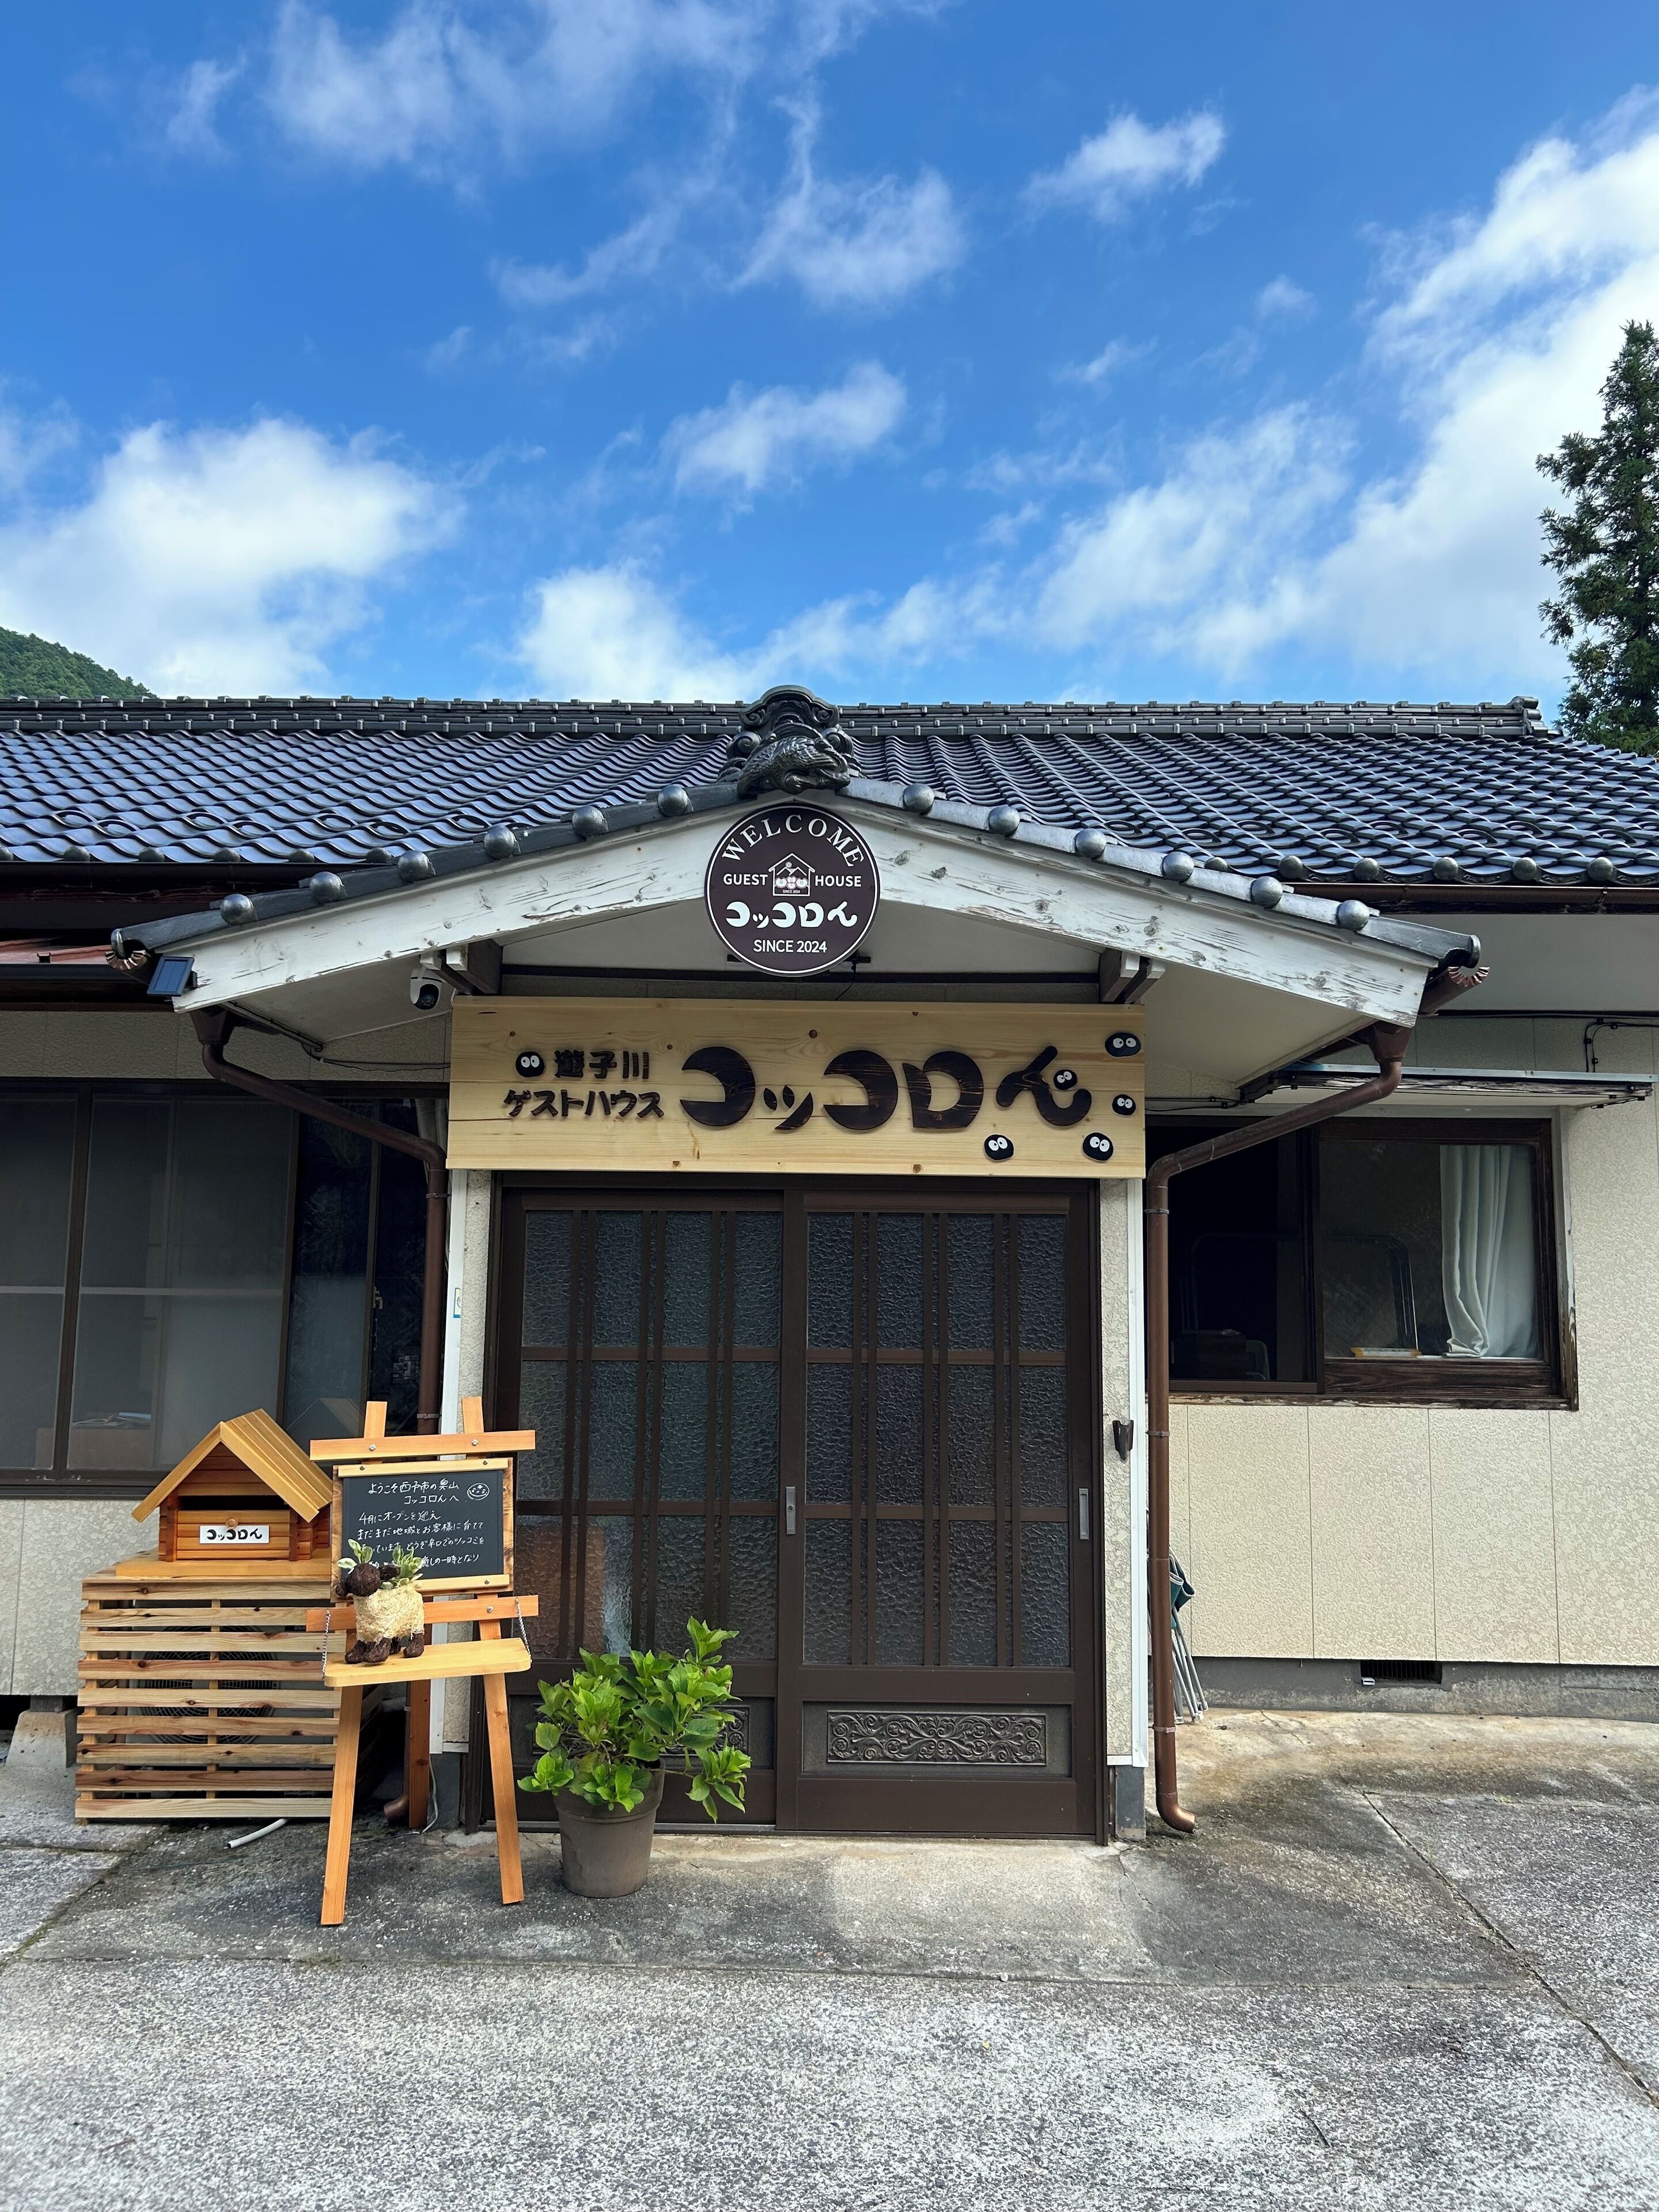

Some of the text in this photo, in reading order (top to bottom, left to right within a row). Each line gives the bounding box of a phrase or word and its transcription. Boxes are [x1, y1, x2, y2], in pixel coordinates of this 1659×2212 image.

[721, 815, 865, 868] WELCOME
[723, 873, 862, 888] GUEST HOUSE
[726, 901, 858, 929] コッコロん
[753, 940, 827, 953] SINCE 2024
[554, 1050, 650, 1080] 遊子川
[679, 1046, 1092, 1131] コッコロん
[503, 1089, 665, 1119] ゲストハウス
[368, 1478, 460, 1494] ようこそ西予市の奥山
[358, 1510, 442, 1525] 4月にオープンを迎え
[206, 1528, 263, 1541] コッコロん
